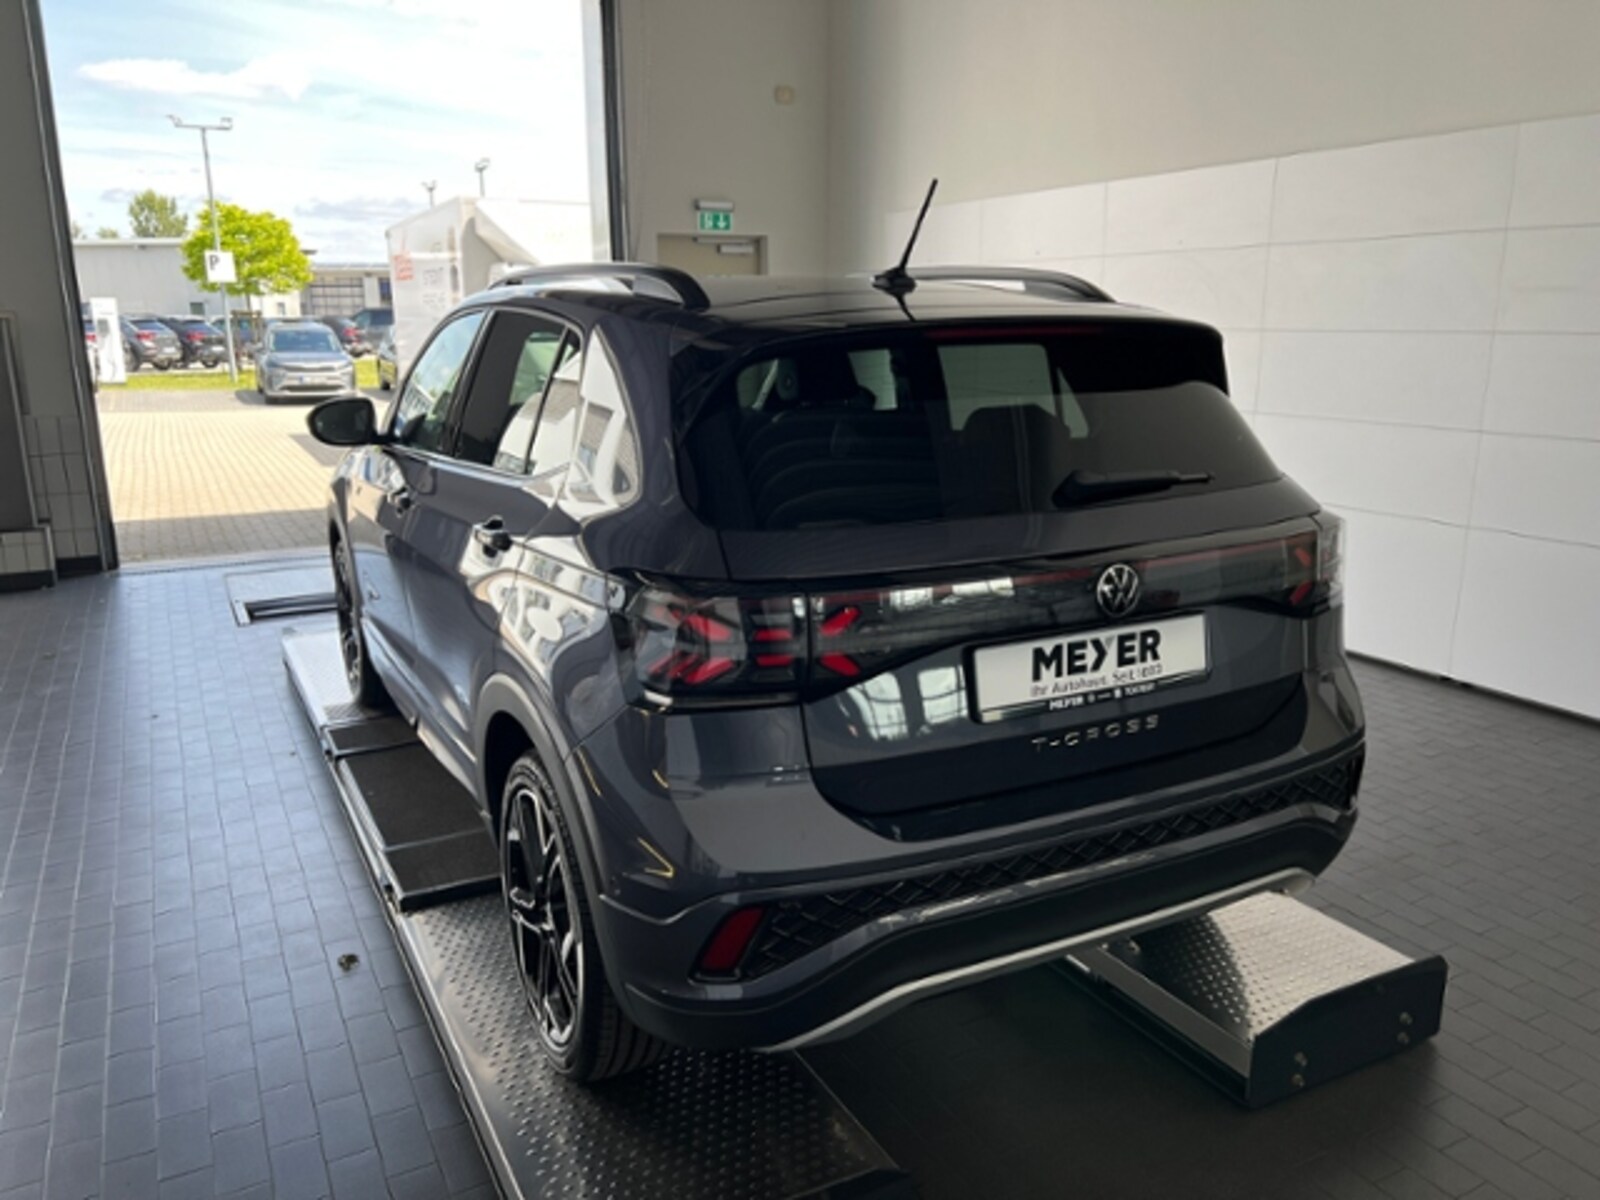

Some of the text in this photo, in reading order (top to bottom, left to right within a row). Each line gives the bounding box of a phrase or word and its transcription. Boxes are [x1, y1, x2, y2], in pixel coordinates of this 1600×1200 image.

[209, 254, 220, 270] P
[1032, 629, 1161, 682] MEYER
[1031, 714, 1158, 752] T-CROSS
